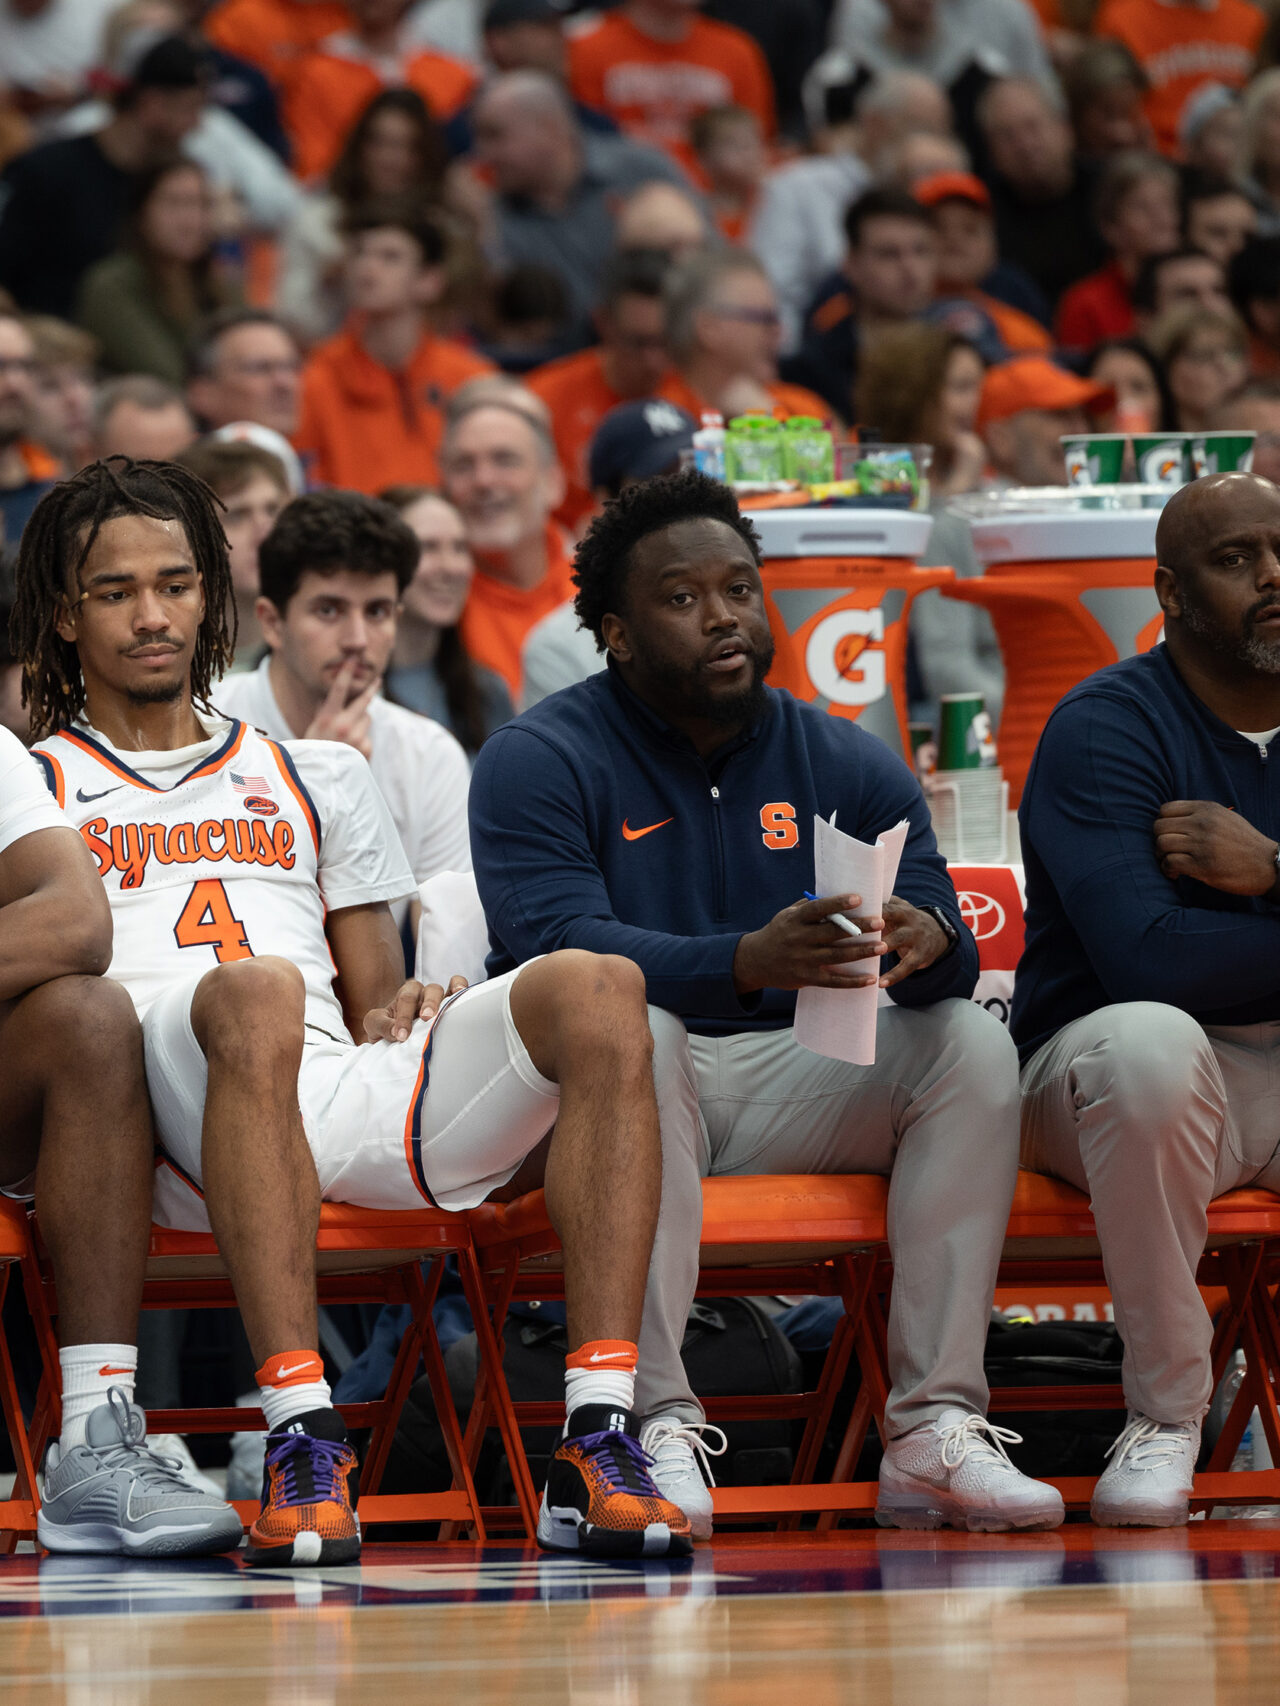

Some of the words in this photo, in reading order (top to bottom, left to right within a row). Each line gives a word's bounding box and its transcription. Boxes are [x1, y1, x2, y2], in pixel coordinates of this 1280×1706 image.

[806, 607, 887, 706] G
[78, 816, 296, 890] Syracuse
[760, 801, 799, 850] S
[173, 877, 256, 964] 4
